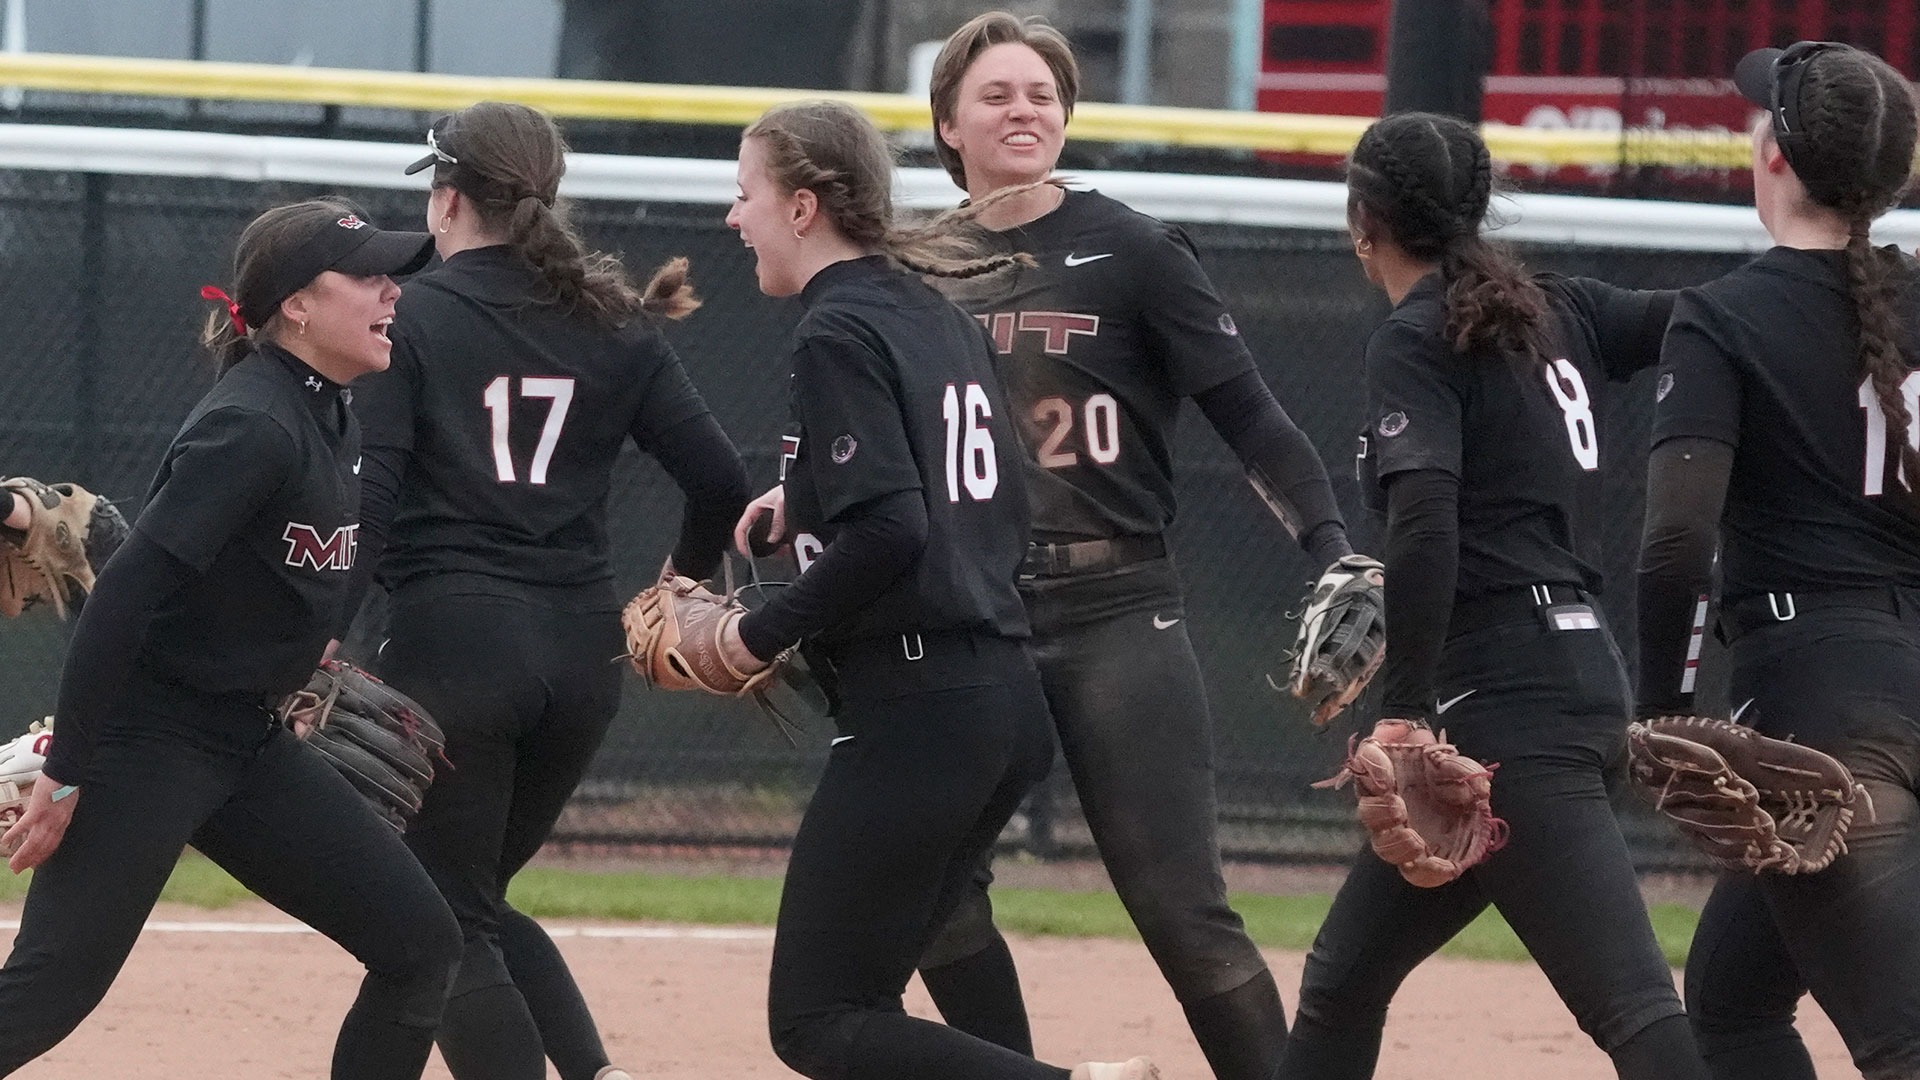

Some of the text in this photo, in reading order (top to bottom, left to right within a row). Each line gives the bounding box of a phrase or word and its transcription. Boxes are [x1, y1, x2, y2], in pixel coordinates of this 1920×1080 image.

[974, 311, 1099, 354] IT
[483, 374, 576, 486] 17
[943, 380, 998, 504] 16
[1034, 393, 1120, 469] 20
[1545, 358, 1599, 471] 8
